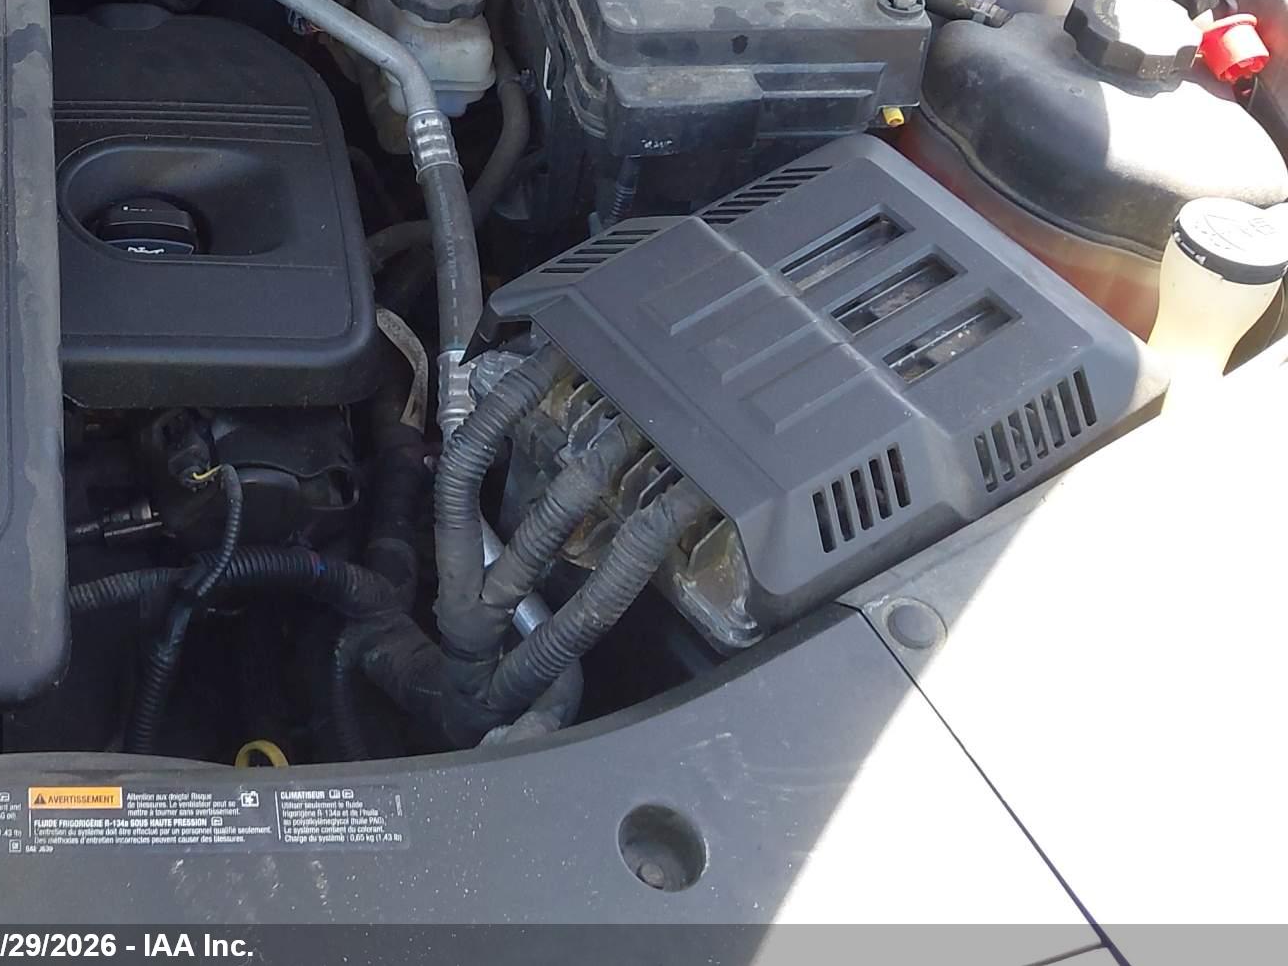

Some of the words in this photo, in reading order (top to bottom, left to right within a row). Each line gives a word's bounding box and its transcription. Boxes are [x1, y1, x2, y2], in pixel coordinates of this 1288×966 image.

[48, 795, 114, 803] AVERTISSEMENT
[34, 819, 58, 827] FLUIDE
[104, 819, 128, 827] R-134a
[130, 819, 148, 827] SOUS
[150, 819, 172, 827] HAUTE
[173, 819, 207, 827] PRESSION
